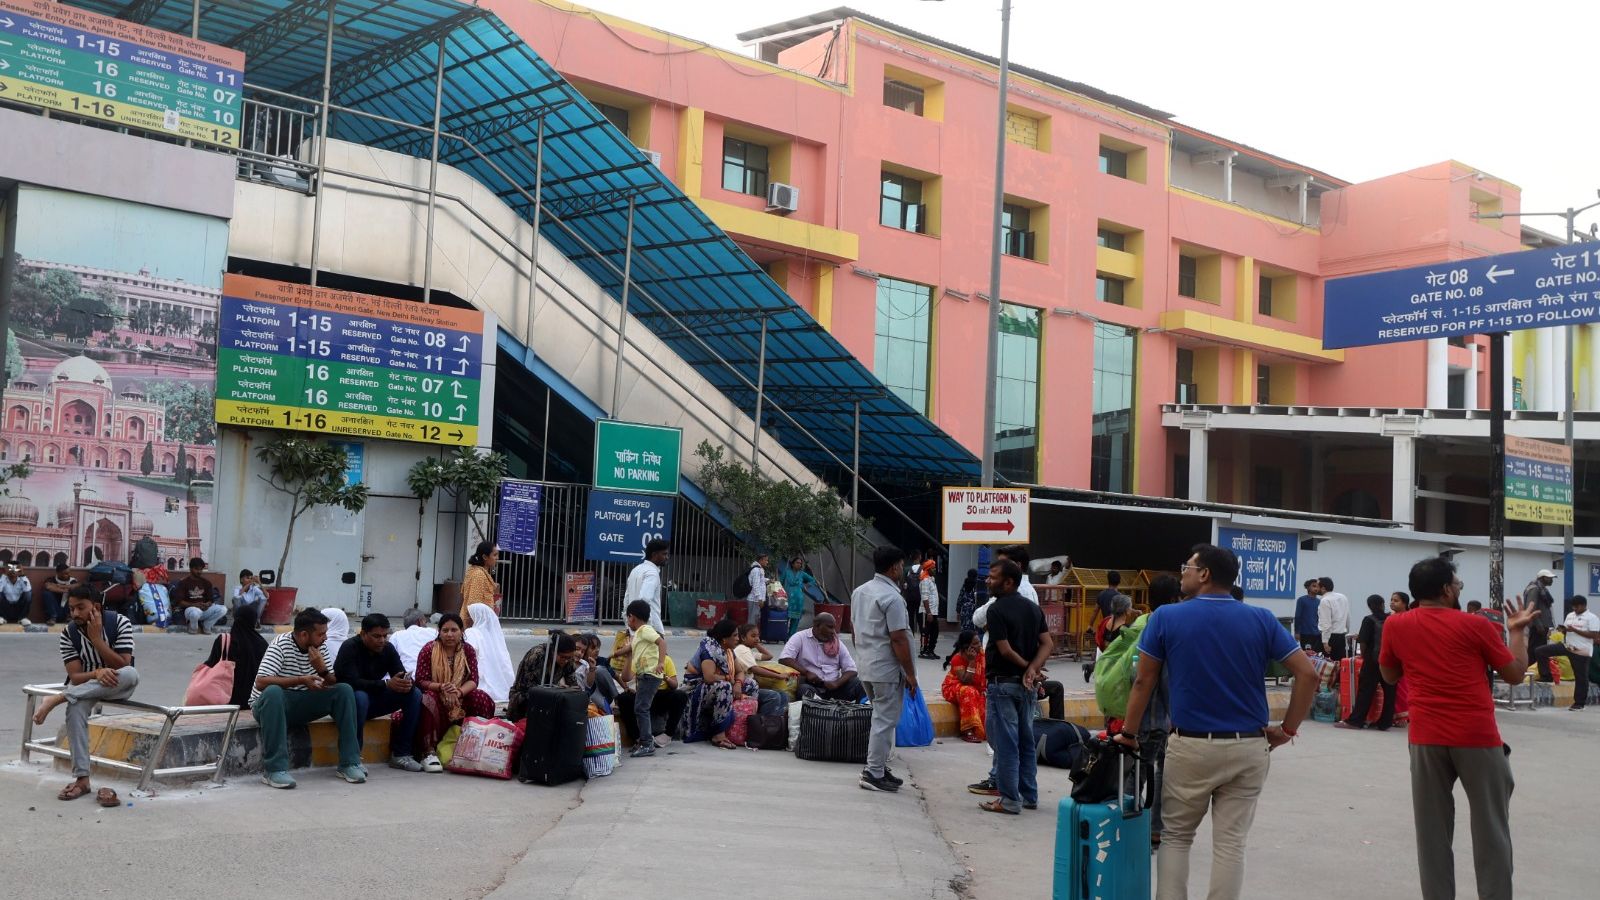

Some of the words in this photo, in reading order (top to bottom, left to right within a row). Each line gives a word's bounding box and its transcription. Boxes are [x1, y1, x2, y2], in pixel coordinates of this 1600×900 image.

[22, 28, 67, 44] PLATFORM
[76, 34, 120, 56] 1-15
[130, 55, 171, 70] RESERVED
[179, 67, 195, 76] Gate
[197, 71, 208, 79] No.
[216, 71, 235, 86] 11
[20, 50, 66, 65] PLATFORM
[94, 60, 118, 77] 16
[129, 76, 170, 90] RESERVED
[177, 86, 194, 96] Gate
[213, 88, 236, 105] 07
[18, 71, 64, 86] PLATFORM
[92, 80, 116, 97] 16
[128, 96, 168, 110] RESERVED
[212, 110, 234, 125] 10
[16, 92, 62, 107] PLATFORM
[71, 96, 115, 117] 1-16
[211, 129, 232, 144] 12
[1551, 252, 1576, 270] गेट
[1425, 270, 1447, 286] गेट
[1450, 268, 1468, 285] 08
[1536, 274, 1572, 288] GATE
[1576, 271, 1600, 283] NO.
[1411, 292, 1442, 304] GATE
[1446, 289, 1466, 300] NO.
[1470, 286, 1483, 297] 08
[242, 304, 276, 316] प्लेटफॉर्म
[349, 320, 376, 330] आरक्षित
[255, 291, 292, 303] Passenger
[294, 298, 312, 307] Entry
[335, 303, 357, 312] Ajmeri
[392, 312, 409, 320] Delhi
[410, 314, 434, 325] Railway
[437, 318, 458, 327] Station
[1382, 309, 1427, 324] प्लेटफॉर्म
[1452, 305, 1480, 317] 1-15
[1485, 298, 1532, 312] आरक्षित
[1537, 293, 1564, 306] नीले
[1569, 291, 1588, 302] रंग
[236, 314, 280, 326] PLATFORM
[289, 312, 332, 332] 1-15
[342, 329, 382, 340] RESERVED
[391, 335, 406, 344] Gate
[424, 332, 446, 348] 08
[1378, 325, 1438, 338] RESERVED
[1442, 322, 1466, 332] FOR
[1470, 320, 1485, 328] PF
[1488, 316, 1512, 327] 1-15
[1516, 314, 1533, 323] TO
[1537, 307, 1594, 322] FOLLOW
[242, 329, 274, 340] प्लेटफॉर्म
[348, 344, 375, 354] आरक्षित
[234, 340, 278, 352] PLATFORM
[287, 336, 331, 356] 1-15
[341, 353, 380, 364] RESERVED
[390, 360, 405, 368] Gate
[424, 354, 443, 370] 11
[240, 354, 272, 365] प्लेटफॉर्म
[233, 365, 277, 376] PLATFORM
[306, 364, 329, 381] 16
[340, 378, 379, 388] RESERVED
[422, 378, 443, 394] 07
[238, 380, 271, 390] प्लेटफॉर्म
[232, 390, 276, 401] PLATFORM
[305, 388, 328, 405] 16
[338, 402, 378, 412] RESERVED
[422, 402, 442, 418] 10
[230, 416, 274, 426] PLATFORM
[283, 411, 326, 429] 1-16
[332, 426, 382, 436] UNRESERVED
[420, 425, 440, 440] 12
[615, 450, 638, 465] पार्किंग
[614, 467, 624, 478] NO
[628, 468, 660, 482] PARKING
[614, 498, 650, 508] RESERVED
[948, 492, 964, 503] WAY
[966, 492, 975, 503] TO
[976, 492, 1008, 503] PLATFORM
[595, 510, 632, 522] PLATFORM
[634, 510, 664, 529] 1-15
[967, 506, 977, 515] 50
[991, 506, 1012, 514] AHEAD
[599, 532, 624, 543] GATE
[1257, 539, 1286, 552] RESERVED
[1246, 578, 1264, 590] PLATFORM
[1265, 557, 1287, 592] 1-15
